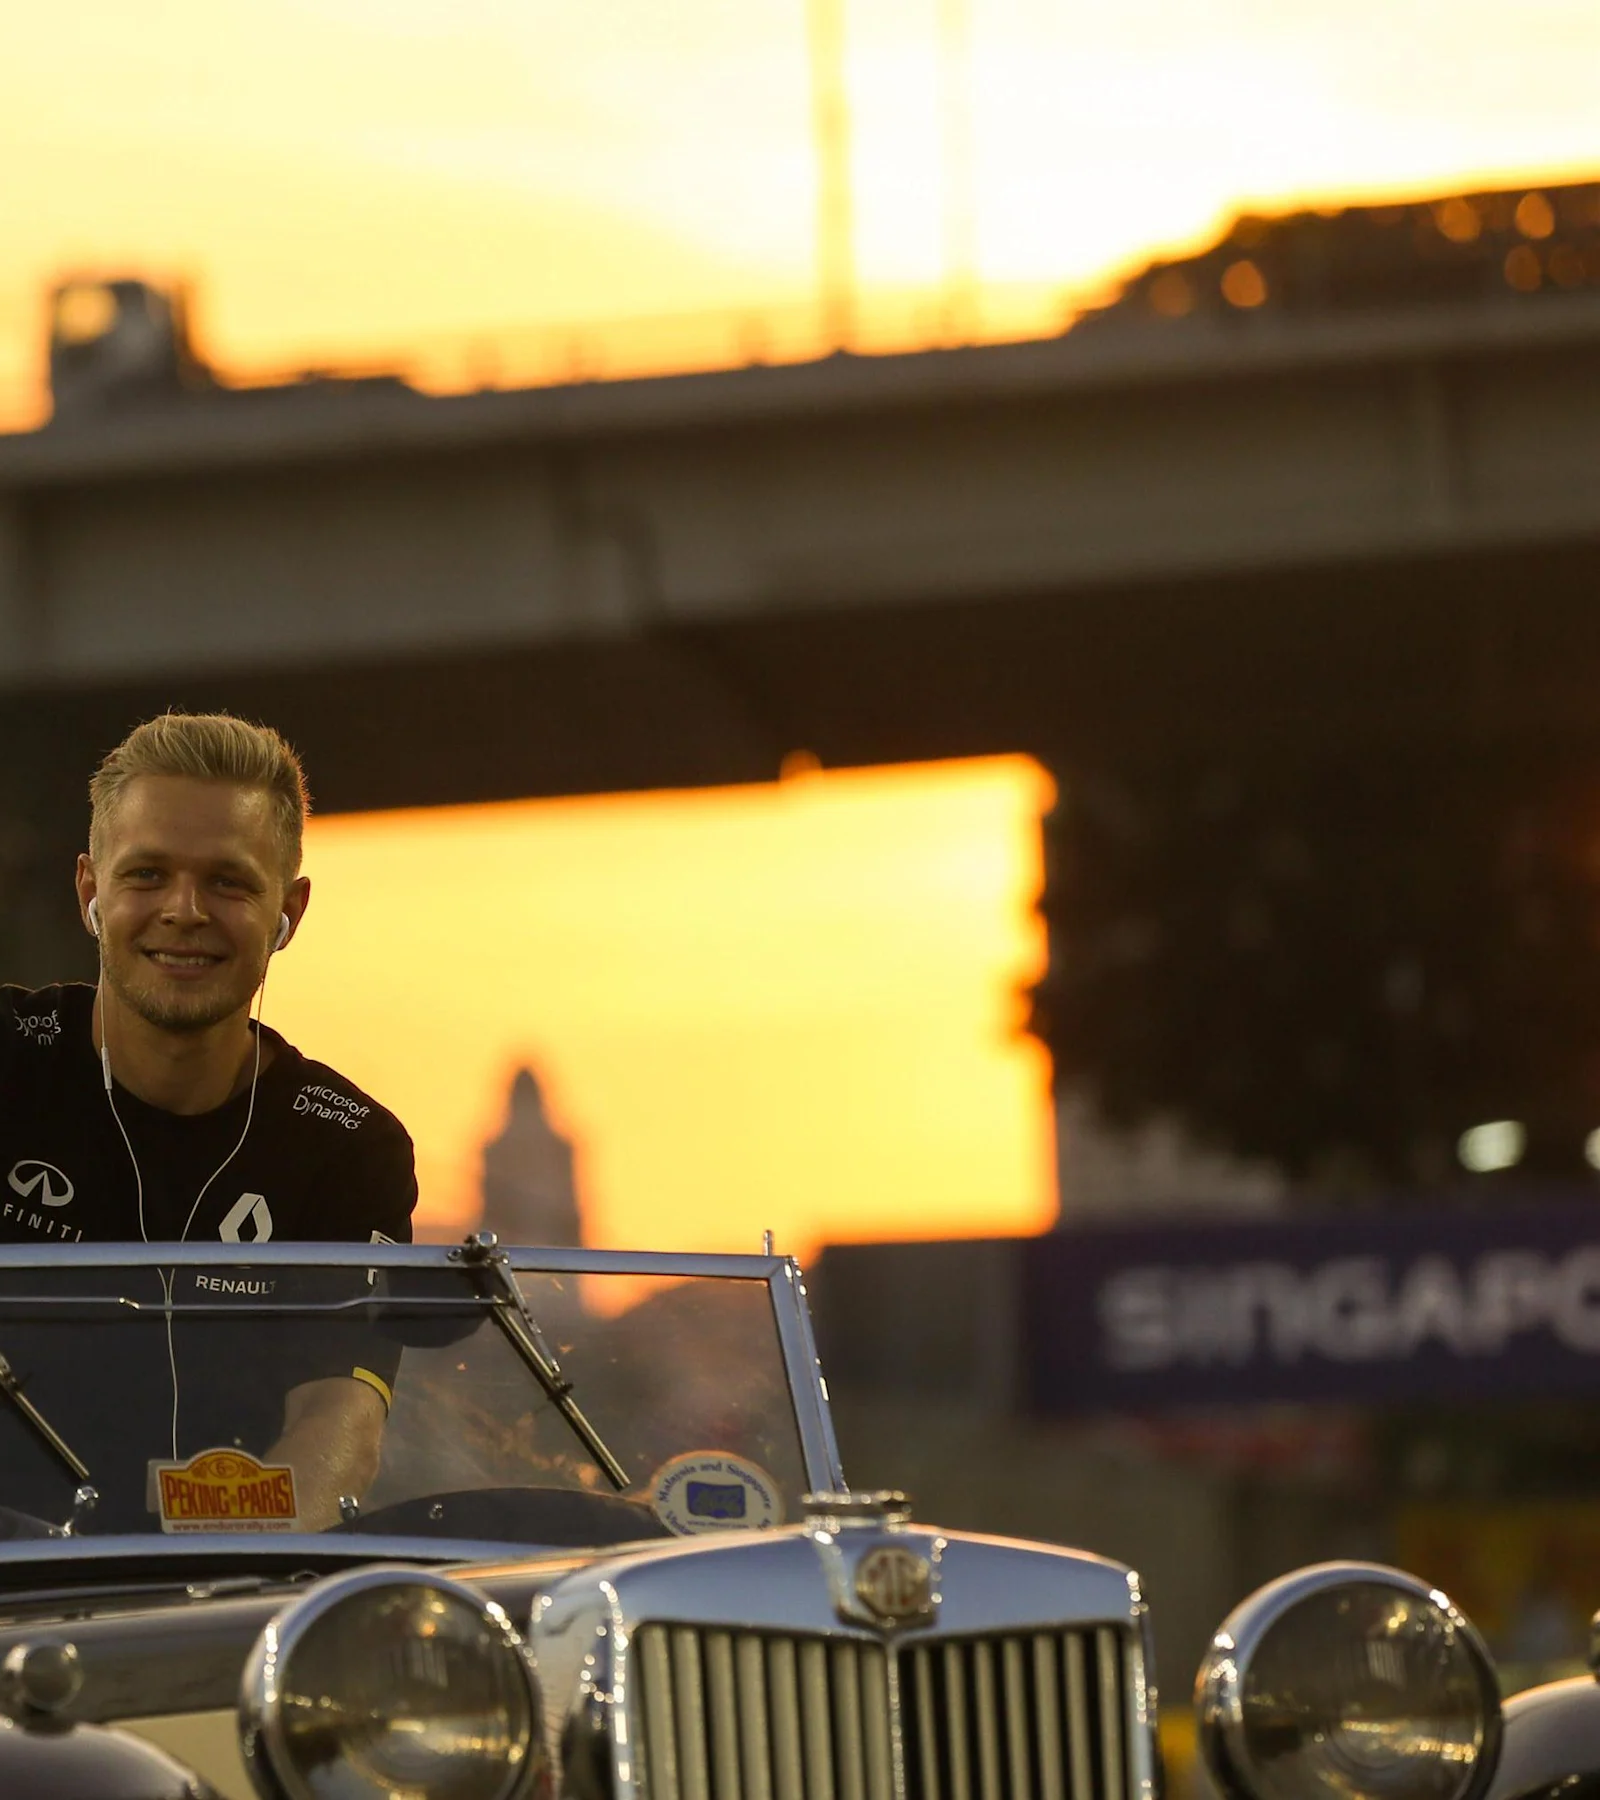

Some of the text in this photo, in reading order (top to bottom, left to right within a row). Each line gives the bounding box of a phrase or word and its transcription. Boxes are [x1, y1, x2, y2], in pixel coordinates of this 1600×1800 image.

[292, 1094, 362, 1130] Dynamics
[301, 1084, 370, 1118] Microsoft
[195, 1274, 277, 1295] RENAULT
[164, 1473, 291, 1517] PEKING PARIS
[658, 1464, 697, 1503] Malaysia
[700, 1461, 724, 1472] and
[726, 1463, 772, 1510] Singapore
